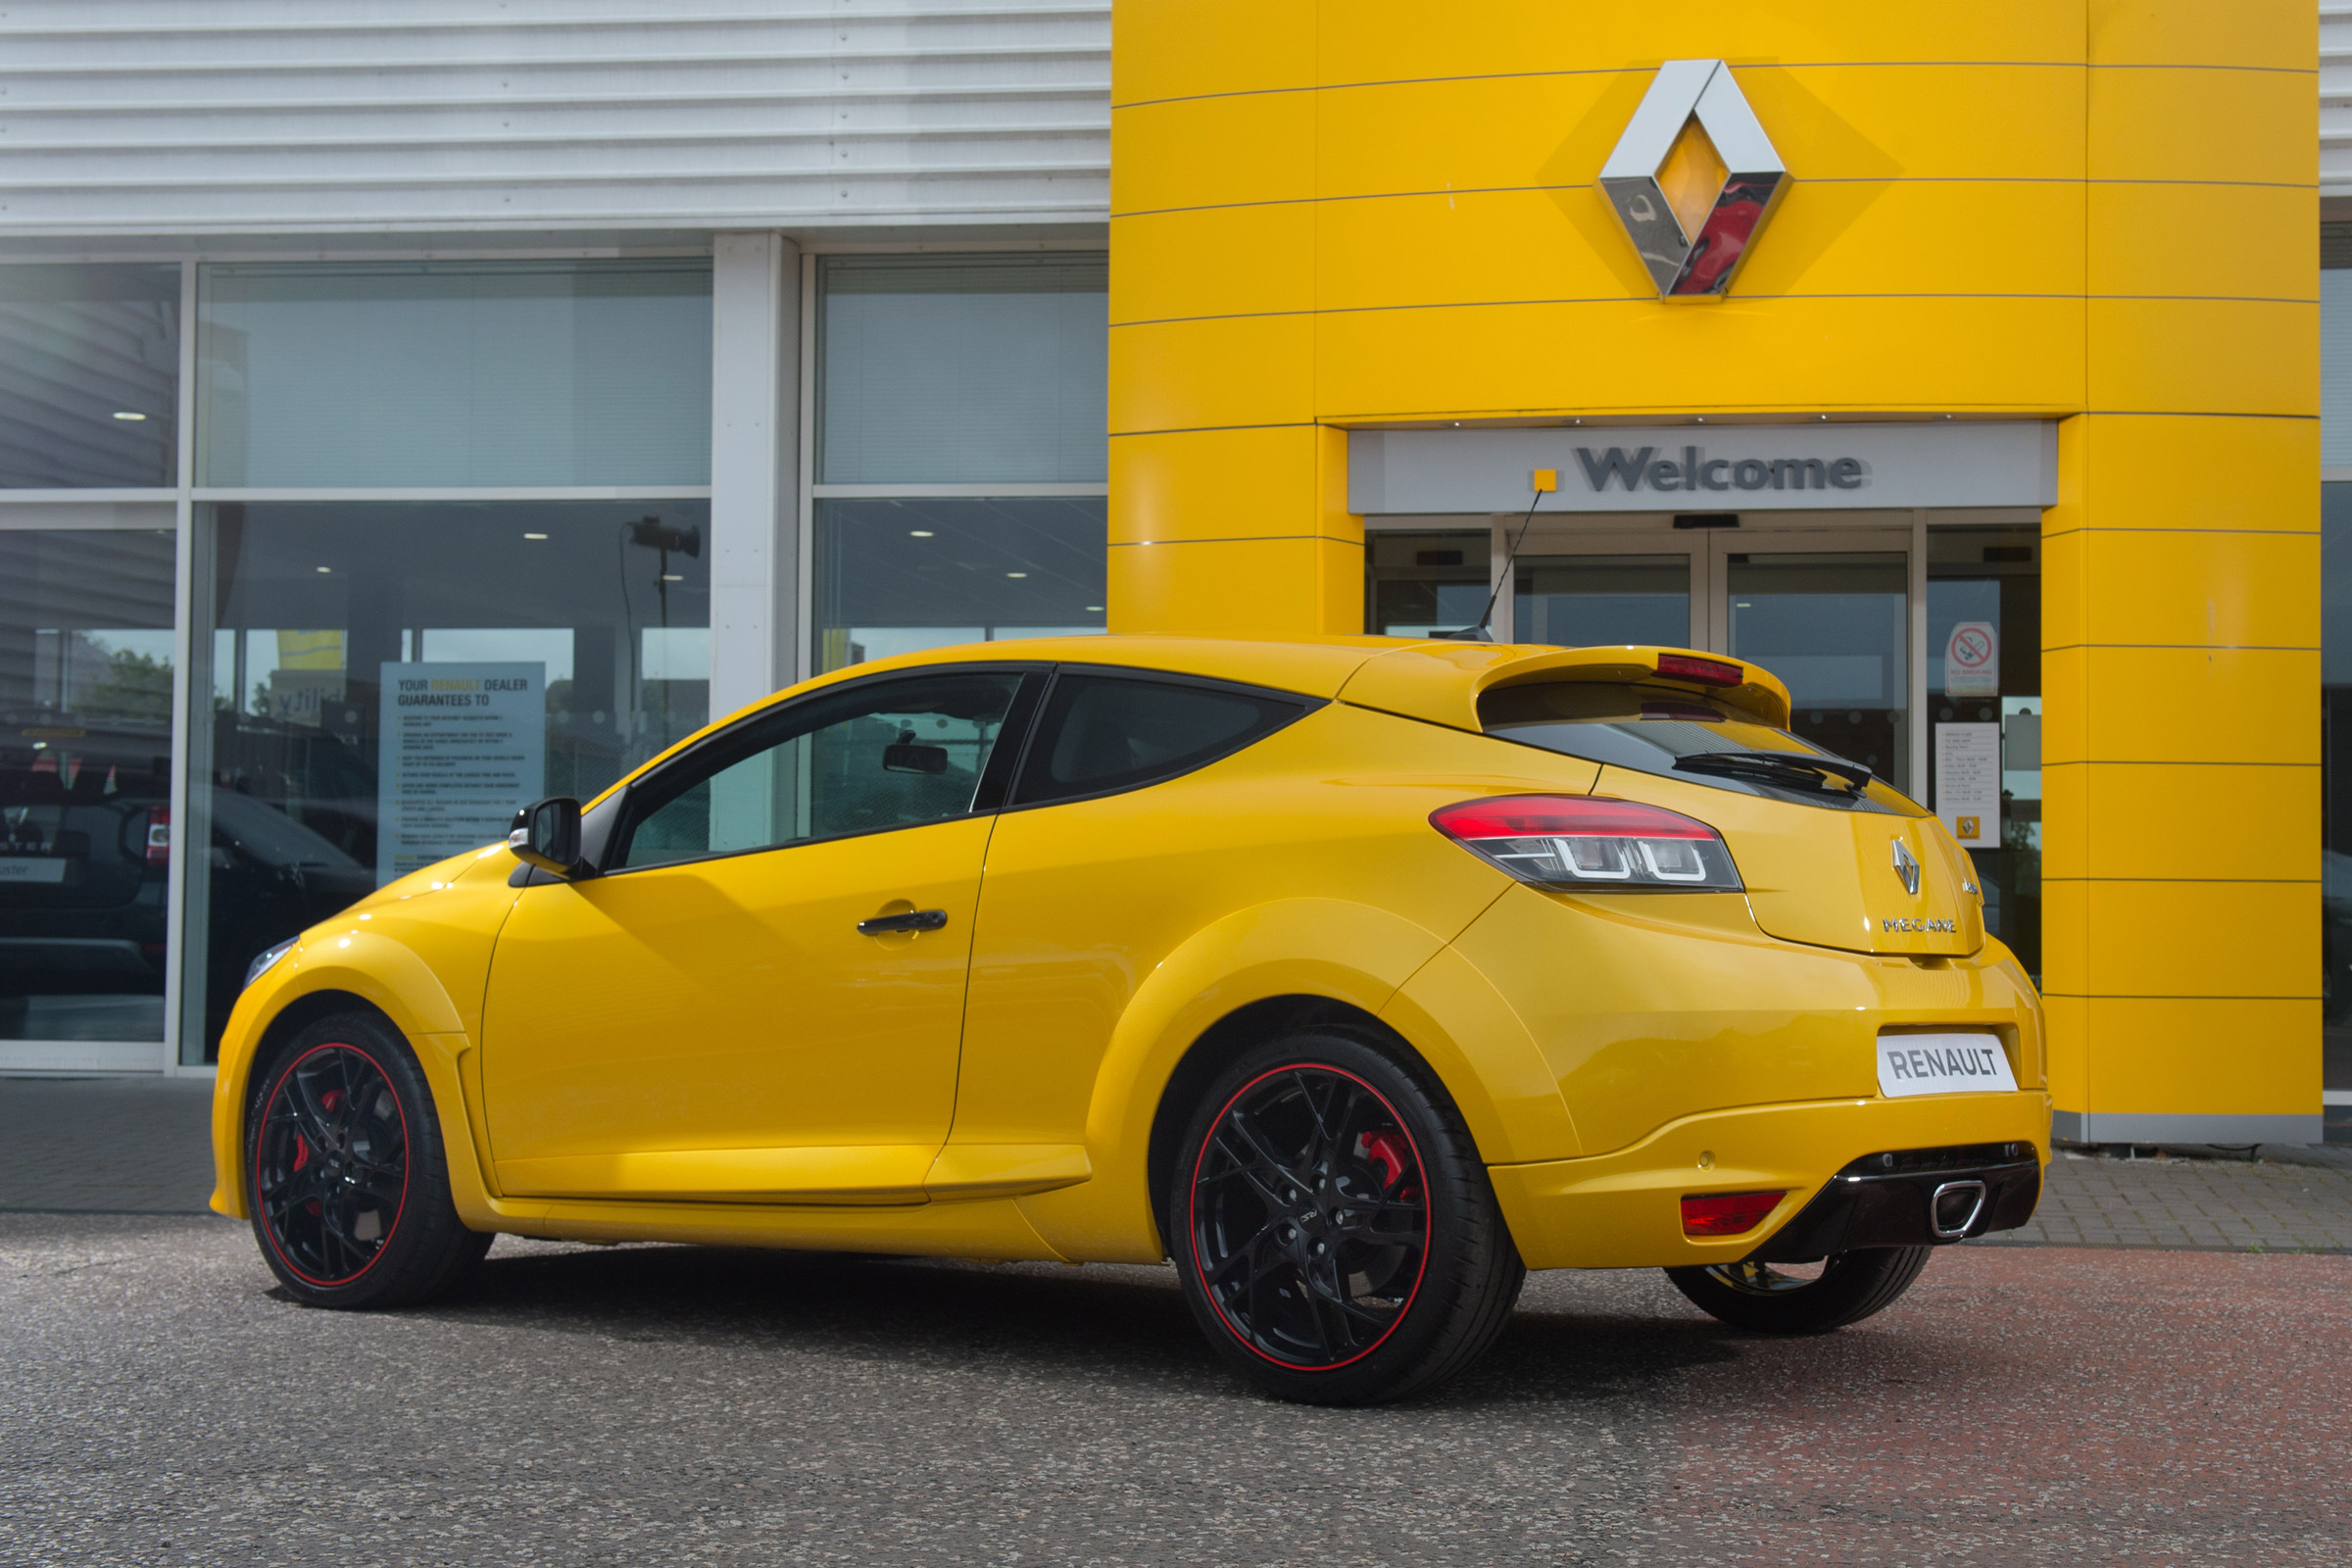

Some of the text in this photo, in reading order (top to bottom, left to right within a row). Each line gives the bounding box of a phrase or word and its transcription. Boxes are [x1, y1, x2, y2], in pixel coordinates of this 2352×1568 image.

[1576, 446, 1863, 491] Welcome
[398, 678, 527, 691] YOUR RENAULT DEALER
[398, 694, 489, 706] GUARANTEES TO
[1883, 918, 1957, 933] MEGANE
[1887, 1048, 1997, 1079] RENAULT
